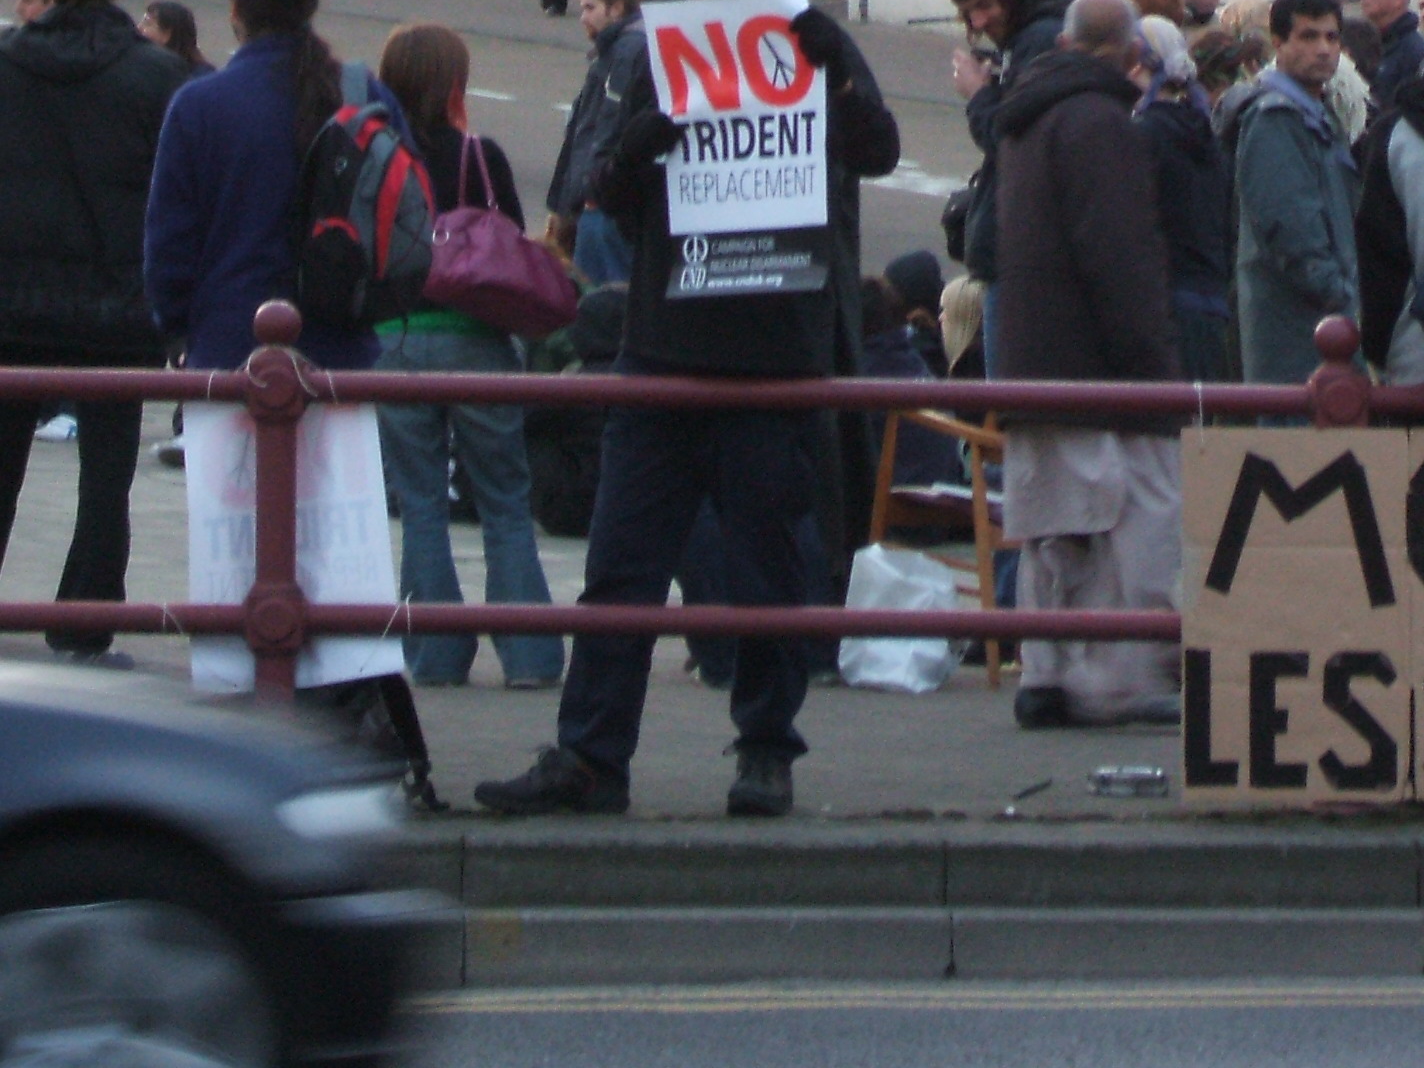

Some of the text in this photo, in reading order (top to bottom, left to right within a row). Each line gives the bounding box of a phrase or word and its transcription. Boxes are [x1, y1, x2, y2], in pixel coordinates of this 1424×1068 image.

[655, 14, 815, 115] NO
[678, 111, 816, 164] TRIDENT
[679, 165, 816, 204] REPLACEMENT
